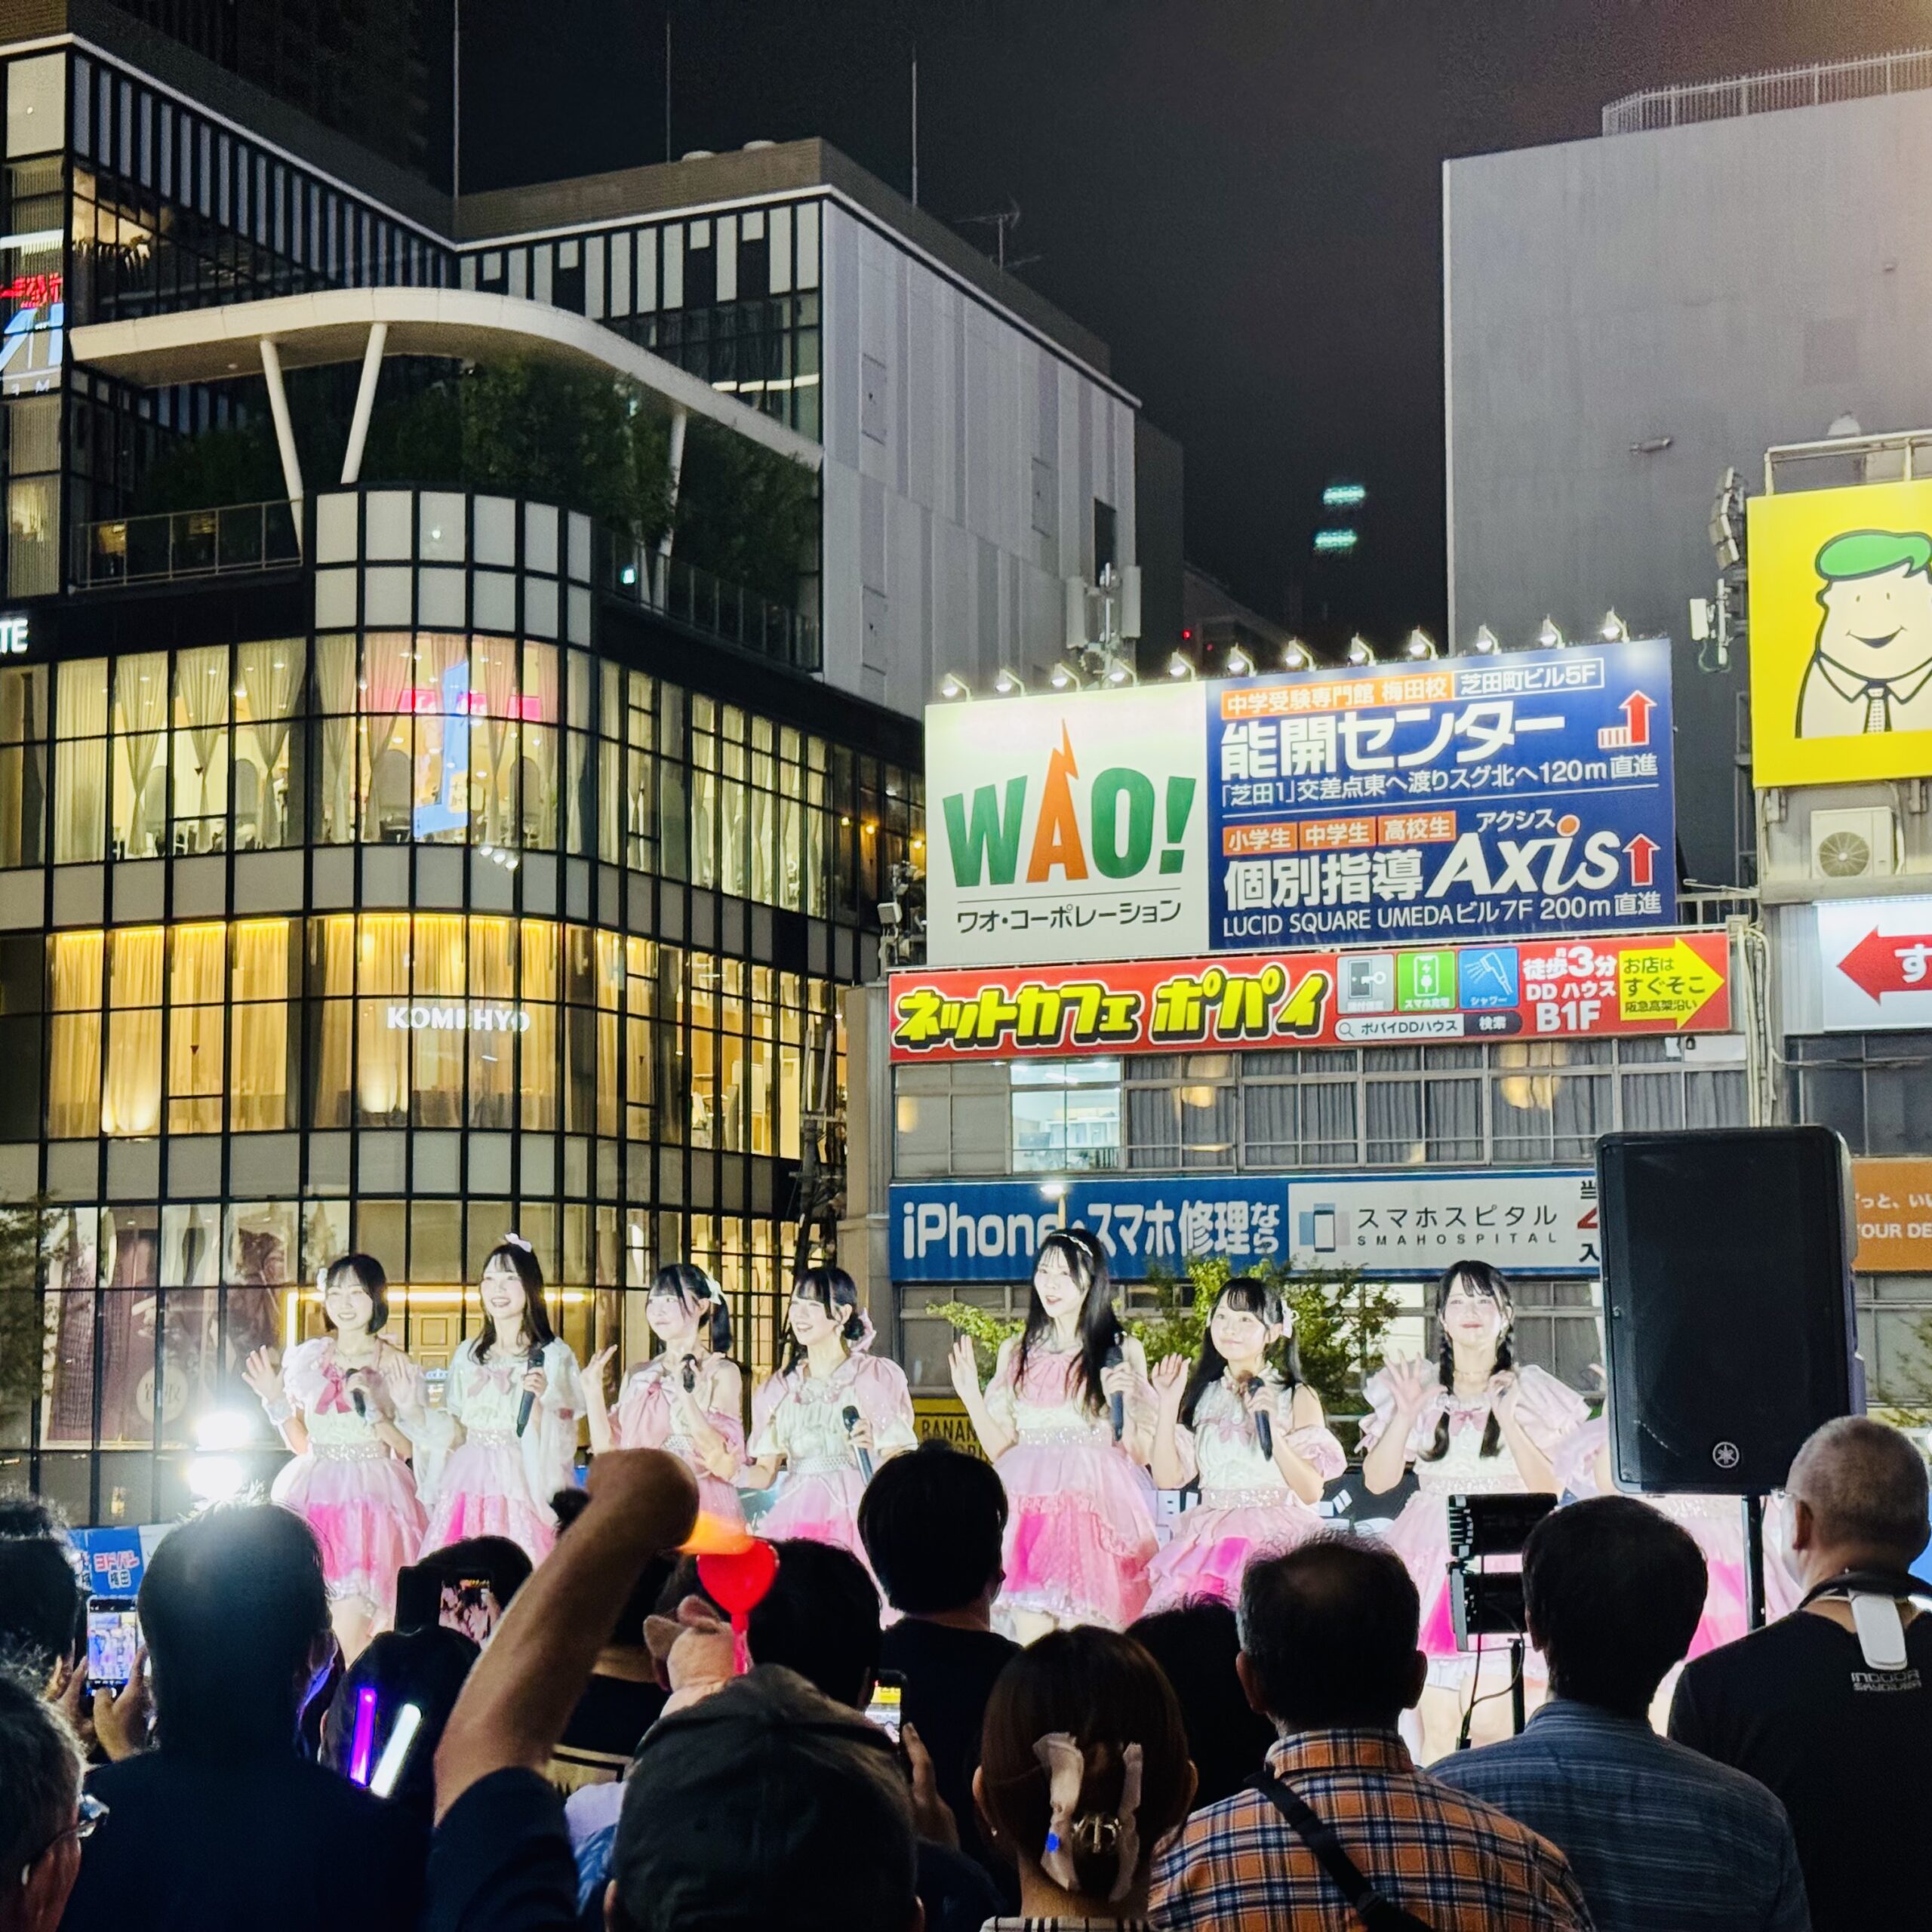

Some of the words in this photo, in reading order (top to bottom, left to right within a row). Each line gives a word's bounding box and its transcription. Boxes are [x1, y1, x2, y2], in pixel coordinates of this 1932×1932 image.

[1460, 664, 1597, 695] 芝田町ビル5F
[1227, 683, 1374, 715] 中学受験専門館
[1382, 677, 1447, 702] 梅田校
[1221, 701, 1565, 780] 能開センター
[943, 718, 1196, 888] WAO!
[1229, 829, 1291, 851] 小学生
[1306, 822, 1370, 847] 中学生
[1384, 816, 1451, 841] 高校生
[1476, 808, 1556, 832] アクシス
[1223, 848, 1424, 912] 個別指導
[957, 899, 1181, 934] ワオ・コーポレーション
[1223, 915, 1283, 937] LUCID
[1289, 909, 1371, 934] SQUARE
[1623, 956, 1674, 974] お店は
[1894, 943, 1932, 983] す
[1470, 995, 1508, 1006] シャワー
[1624, 976, 1705, 998] すぐそこ
[897, 983, 1138, 1048] ネットカフェ
[1152, 965, 1326, 1041] ポパイ
[1537, 1000, 1601, 1032] B1F
[1625, 999, 1697, 1014] 阪急高架沿い
[1478, 1016, 1506, 1030] 検索
[1358, 1204, 1557, 1229] スマホスピタル
[1857, 1223, 1903, 1238] OUR
[1907, 1223, 1932, 1238] DE
[1358, 1232, 1557, 1246] SMAHOSPITAL
